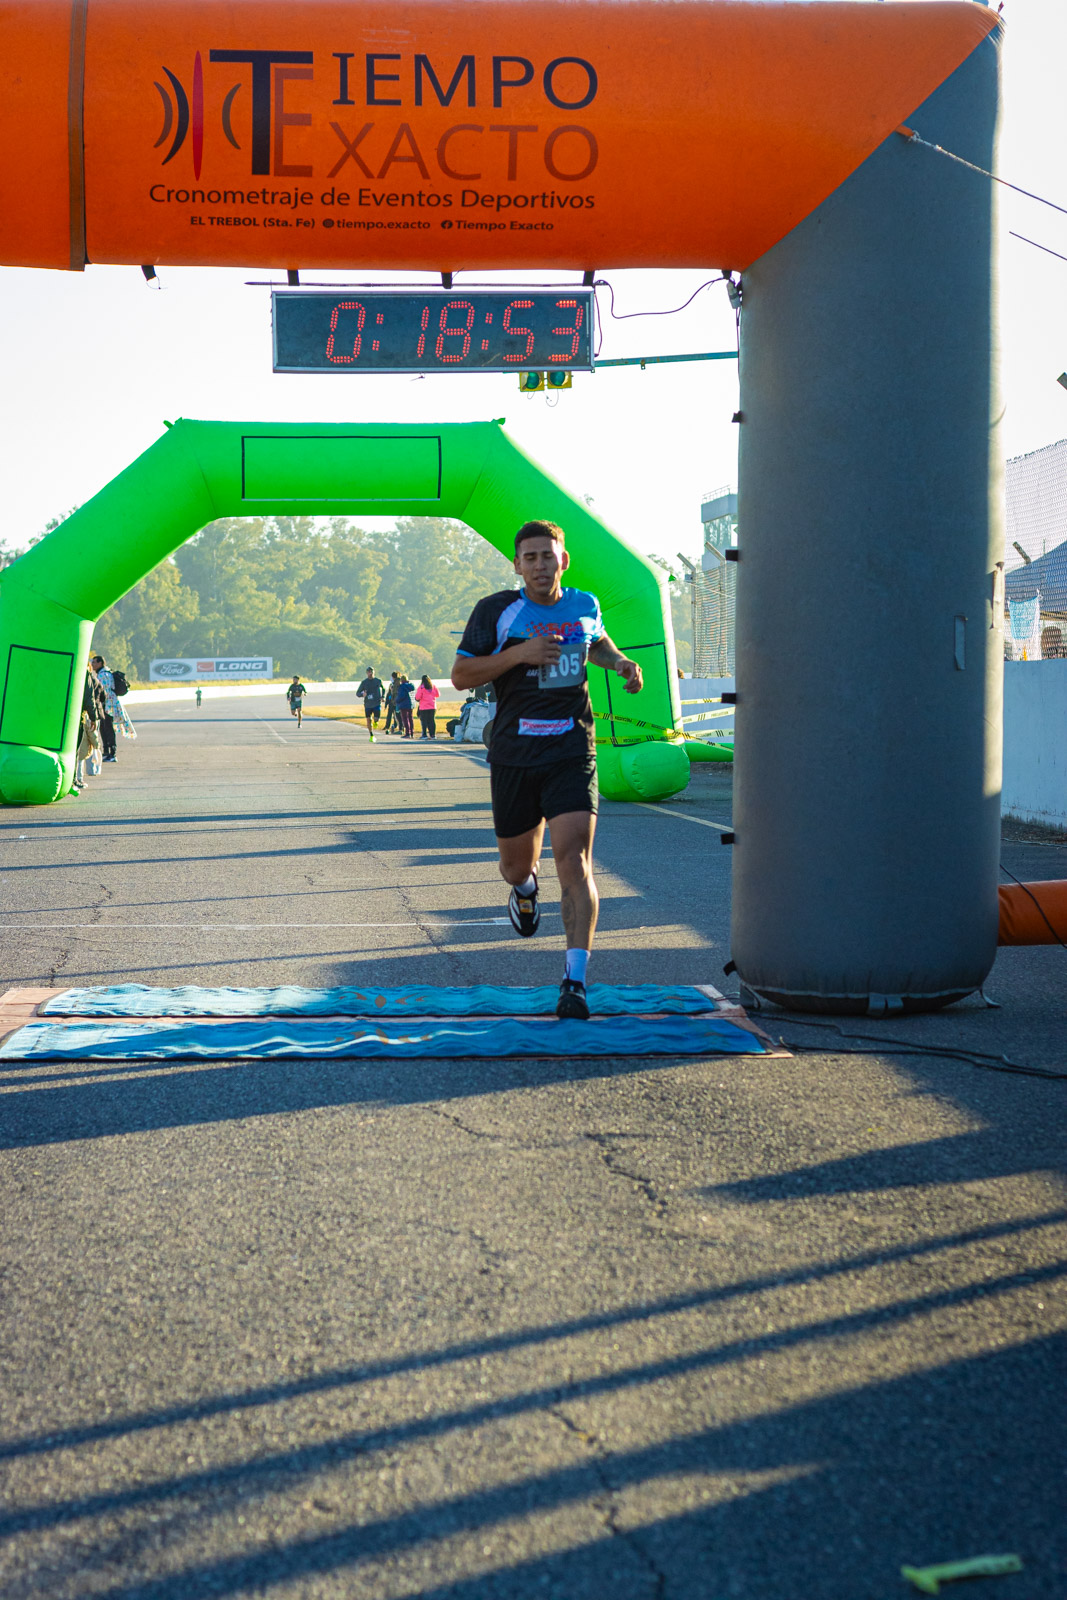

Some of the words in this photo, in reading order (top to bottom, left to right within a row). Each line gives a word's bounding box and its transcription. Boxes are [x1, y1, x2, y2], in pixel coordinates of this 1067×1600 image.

[149, 184, 314, 209] Cronometraje
[320, 187, 351, 206] de
[358, 188, 453, 207] Eventos
[461, 189, 595, 212] Deportivos
[190, 216, 205, 225] EL
[208, 216, 259, 227] TREBOL
[263, 217, 292, 228] (Sta.
[296, 218, 316, 229] Fe)
[455, 219, 507, 232] Tiempo
[510, 220, 554, 230] Exacto
[326, 300, 584, 364] 0:18:53
[160, 663, 185, 674] Ford
[218, 662, 264, 671] LONG
